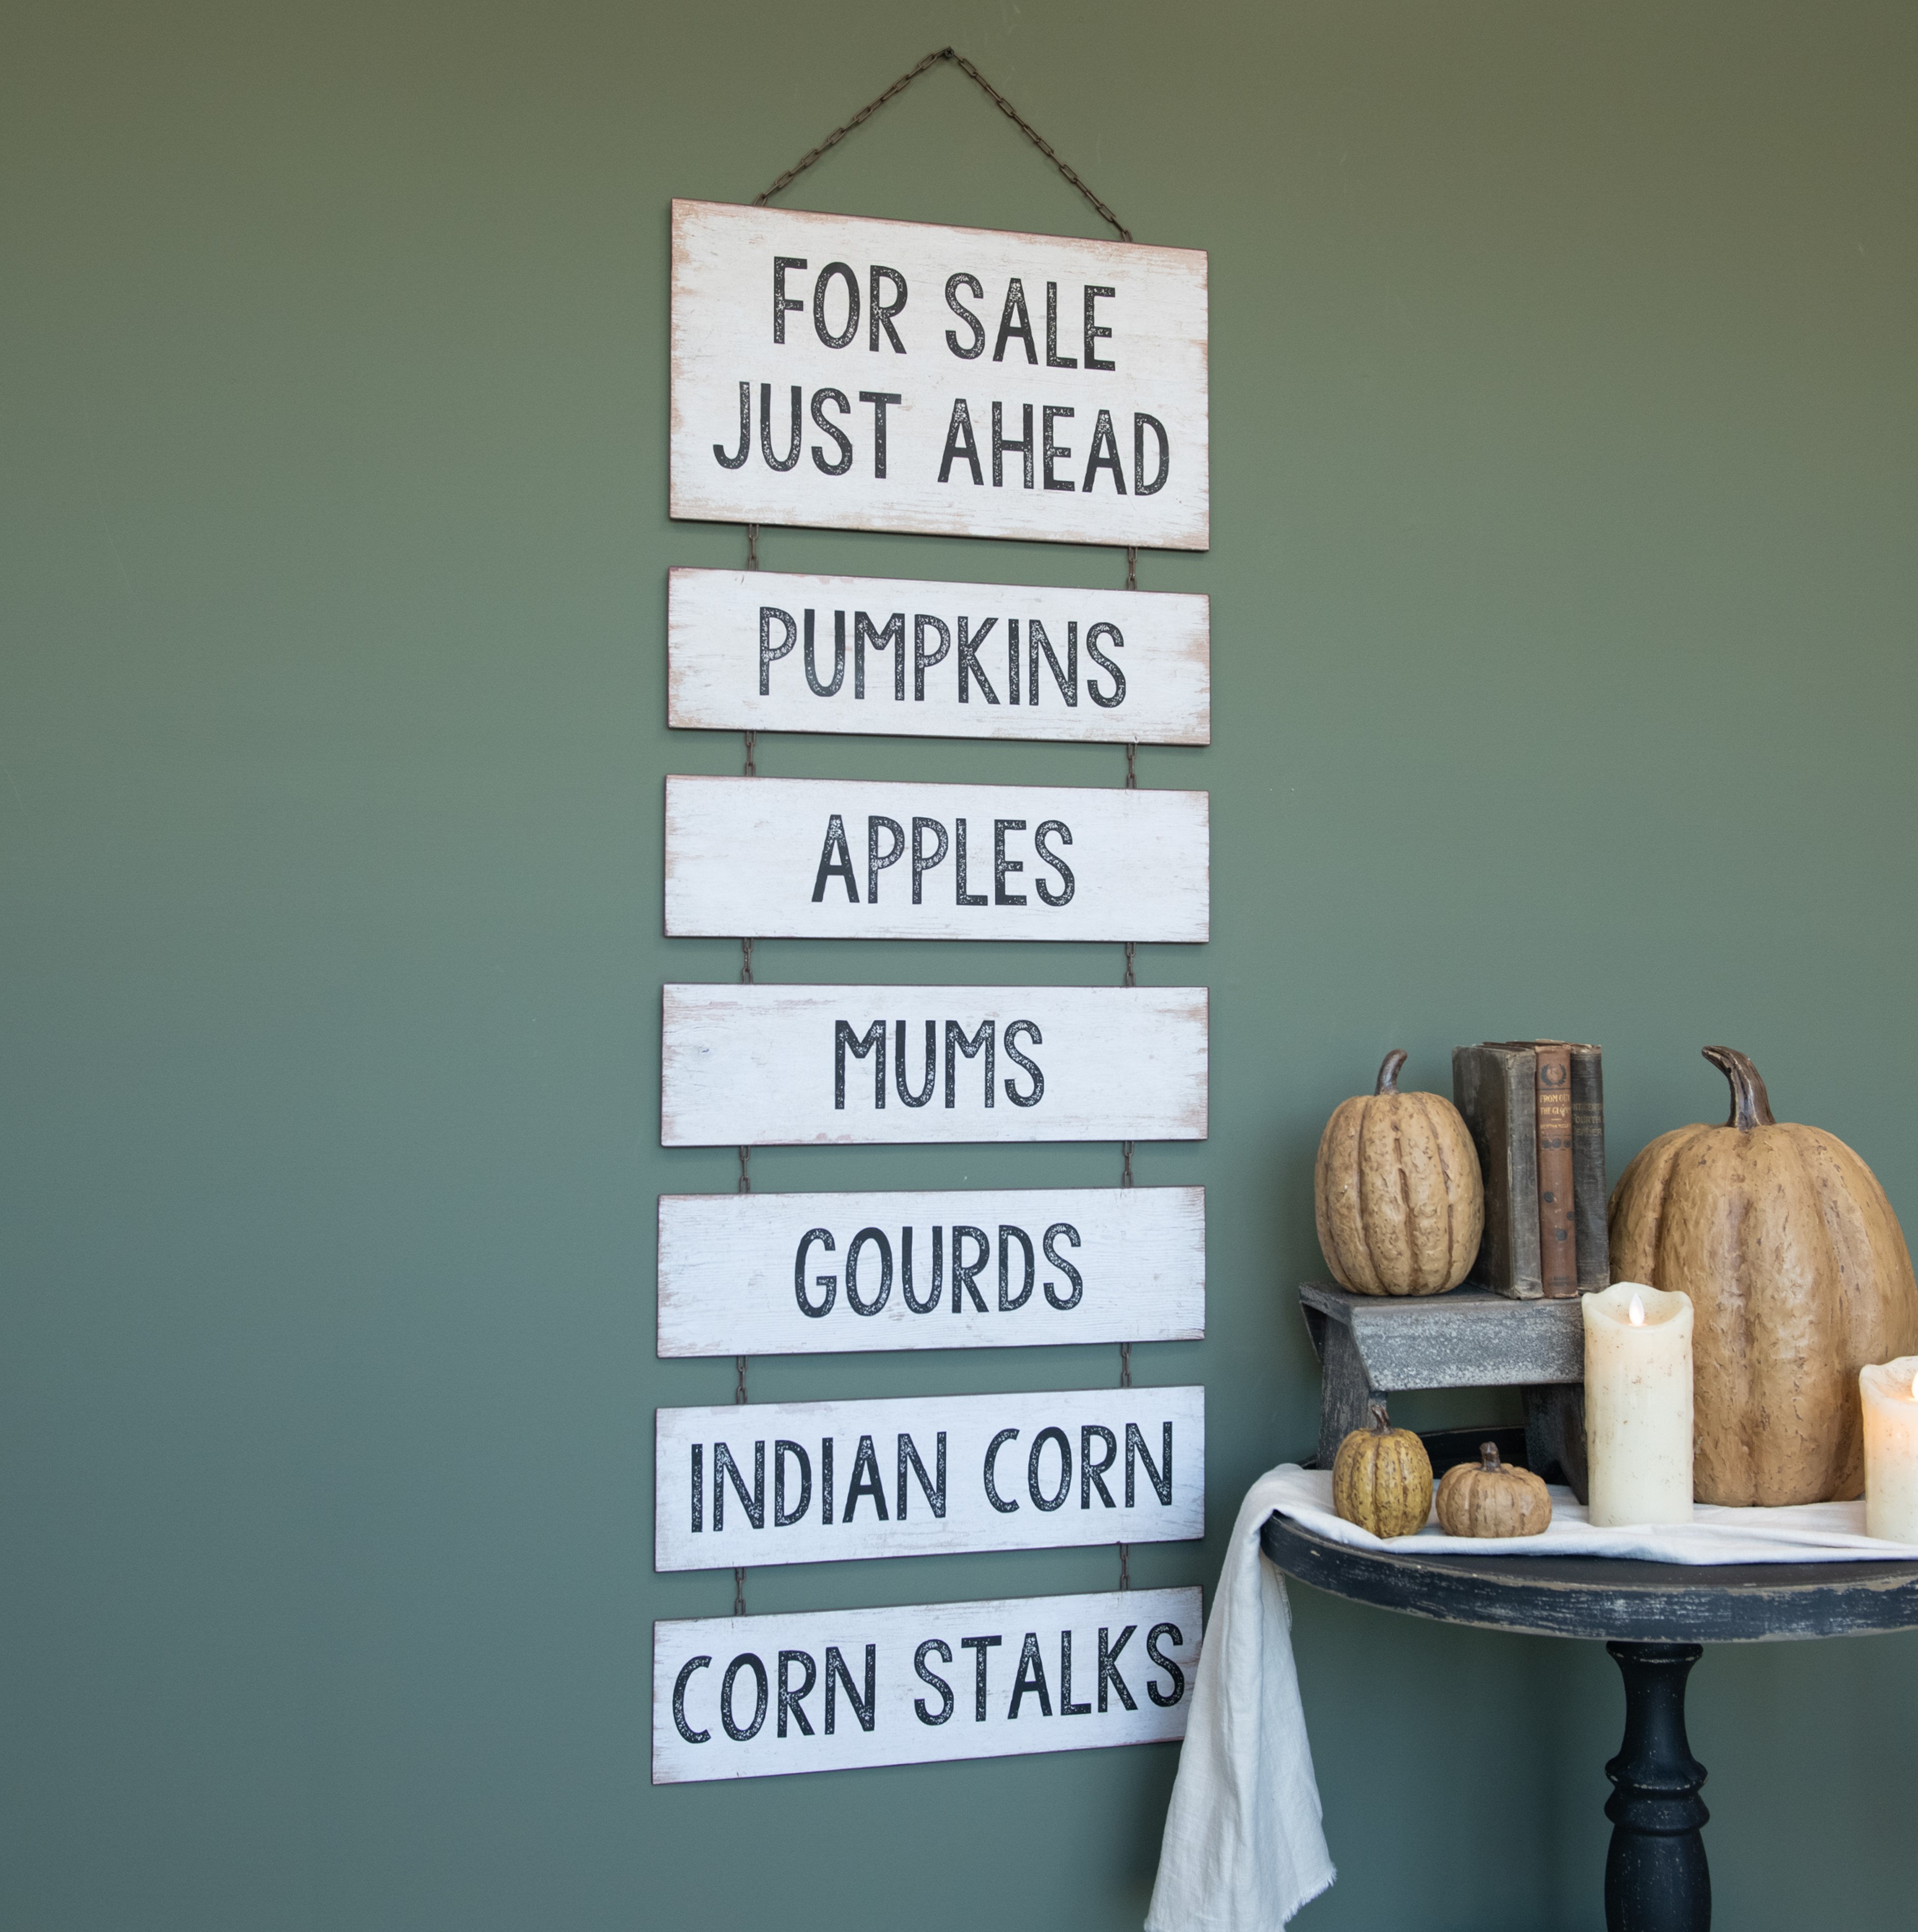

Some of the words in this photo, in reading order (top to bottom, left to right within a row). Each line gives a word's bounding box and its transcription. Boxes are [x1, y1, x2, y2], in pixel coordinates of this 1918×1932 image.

[774, 257, 907, 354] FOR
[945, 273, 1115, 371] SALE
[714, 382, 901, 478] JUST
[938, 399, 1169, 495] AHEAD
[760, 607, 1125, 708] PUMPKINS
[812, 815, 1074, 906] APPLES
[835, 1020, 1044, 1109] MUMS
[1540, 1095, 1558, 1103] FROM
[1540, 1107, 1552, 1115] THE
[795, 1223, 1082, 1317] GOURDS
[692, 1432, 946, 1532] INDIAN
[984, 1422, 1172, 1513] CORN
[672, 1644, 875, 1743] CORN
[914, 1623, 1185, 1726] STALKS
